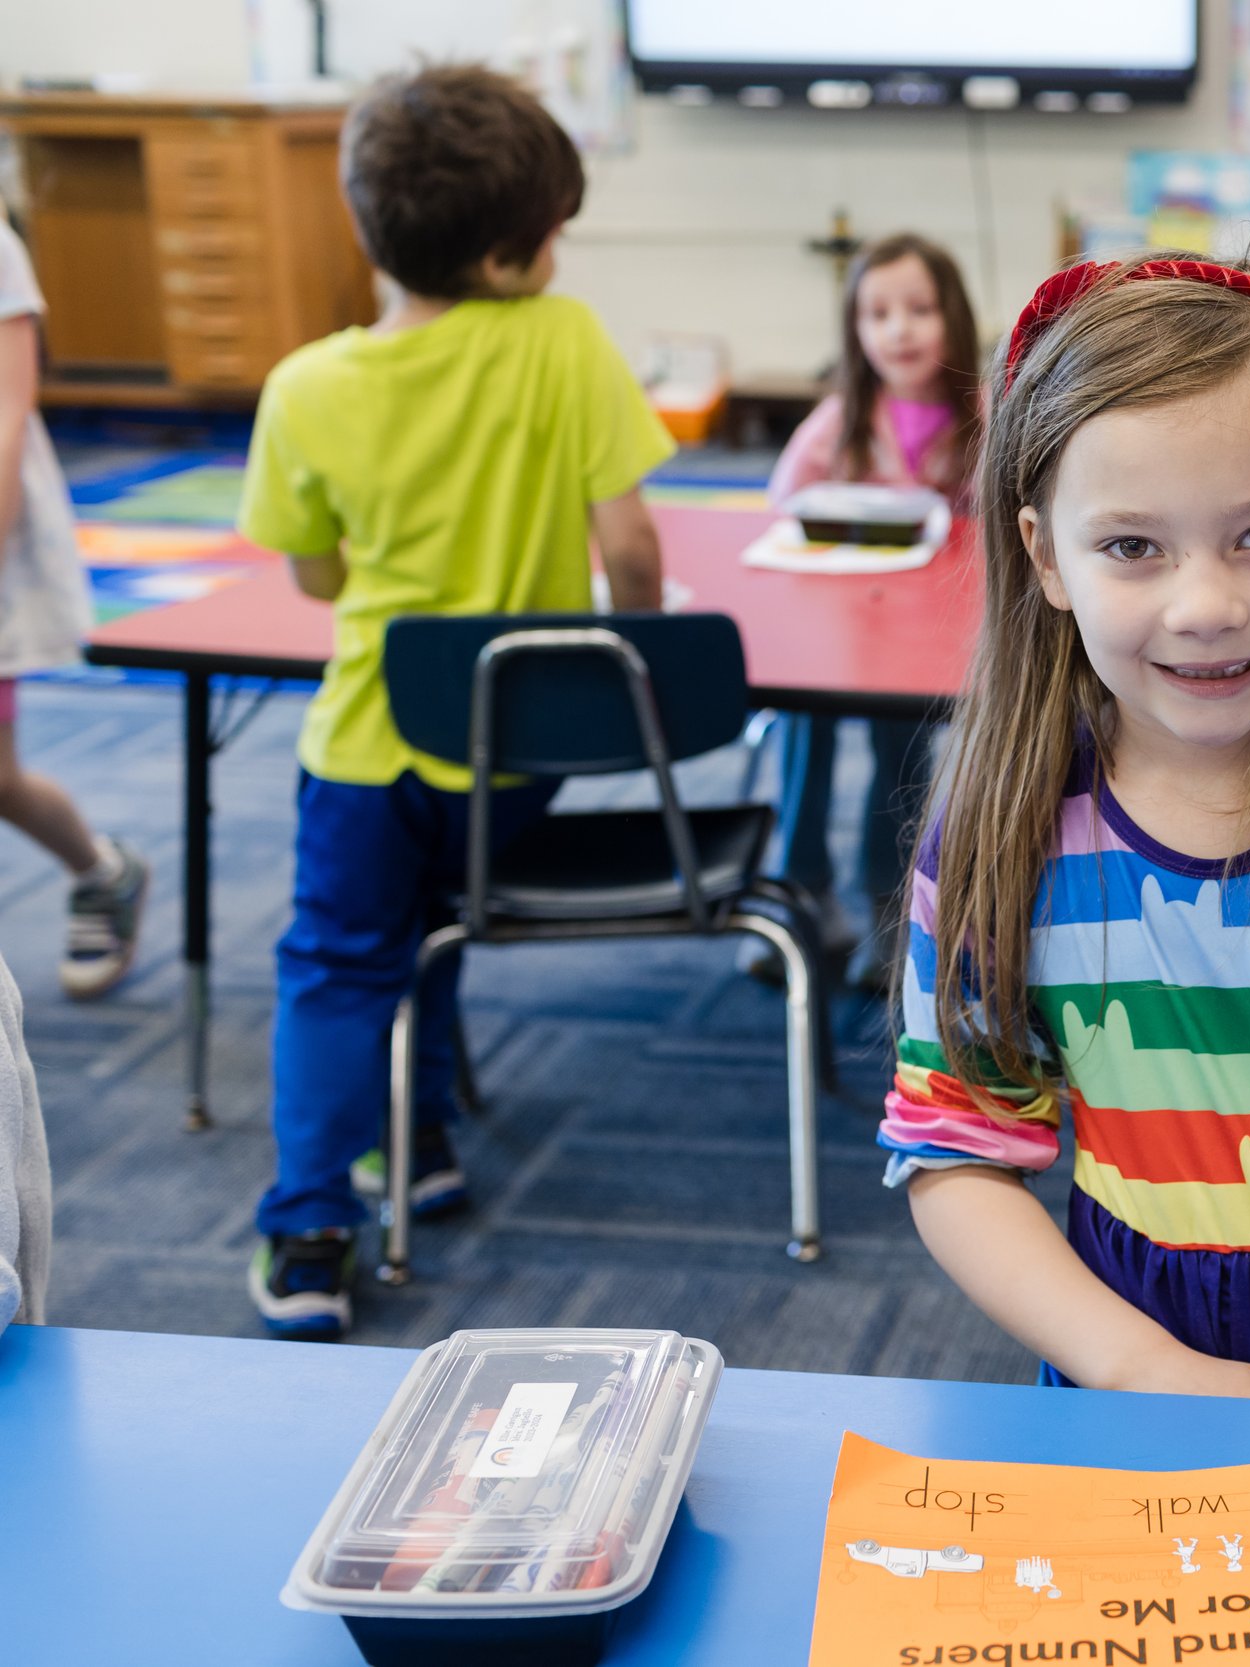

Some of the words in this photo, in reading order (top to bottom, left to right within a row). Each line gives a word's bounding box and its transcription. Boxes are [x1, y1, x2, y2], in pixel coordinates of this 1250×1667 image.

[905, 1466, 1005, 1532] stop
[1132, 1494, 1229, 1533] walk
[1100, 1598, 1177, 1626] Me
[899, 1638, 1147, 1667] Numbers
